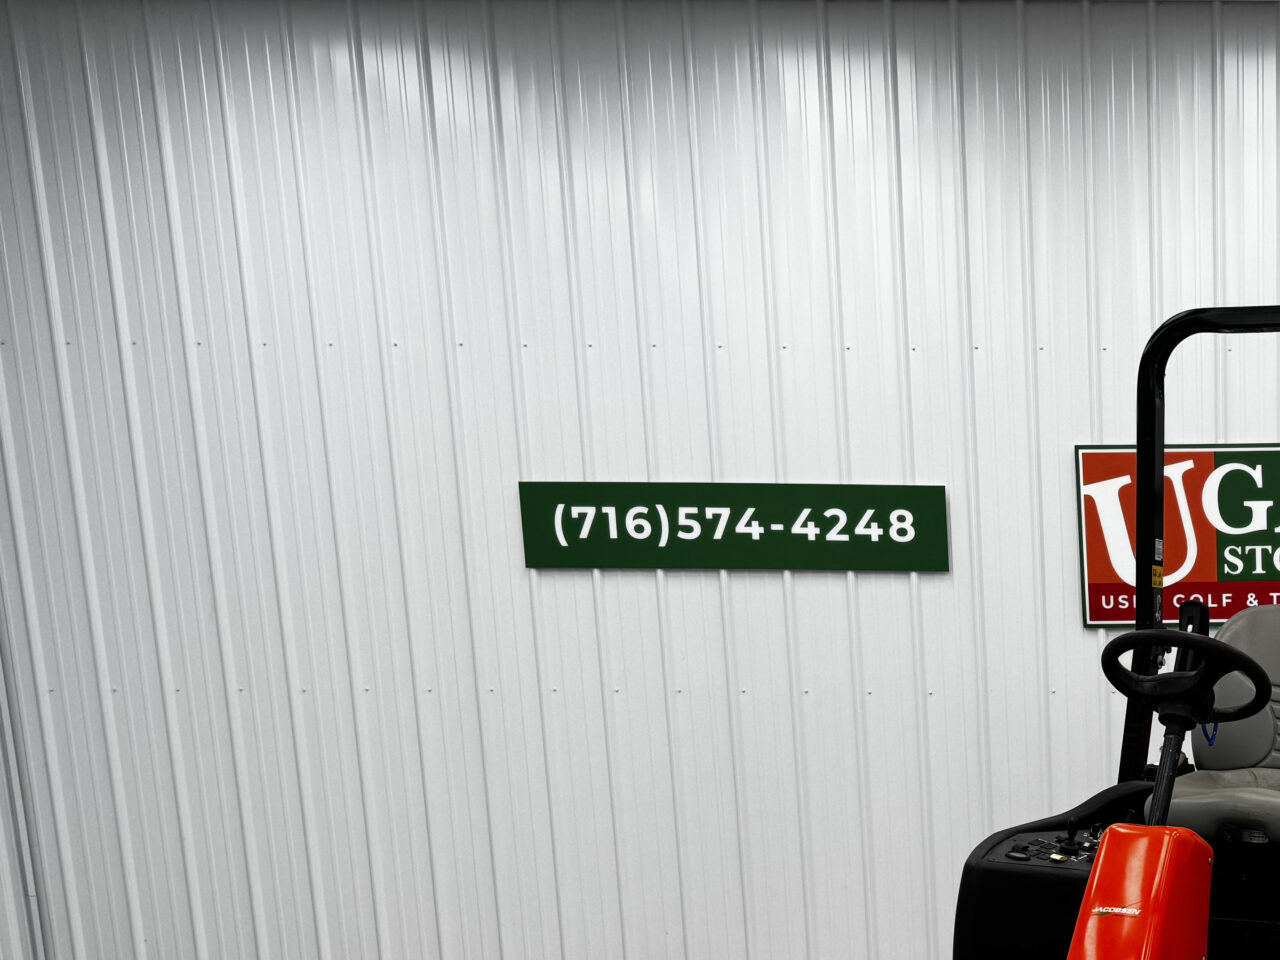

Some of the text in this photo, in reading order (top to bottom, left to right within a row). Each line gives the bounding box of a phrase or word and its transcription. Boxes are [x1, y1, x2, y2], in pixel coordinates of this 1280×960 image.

[553, 504, 916, 547] (716)574-4248
[1101, 594, 1137, 609] US
[1246, 593, 1259, 607] &
[1091, 906, 1142, 915] JACOBSEN
